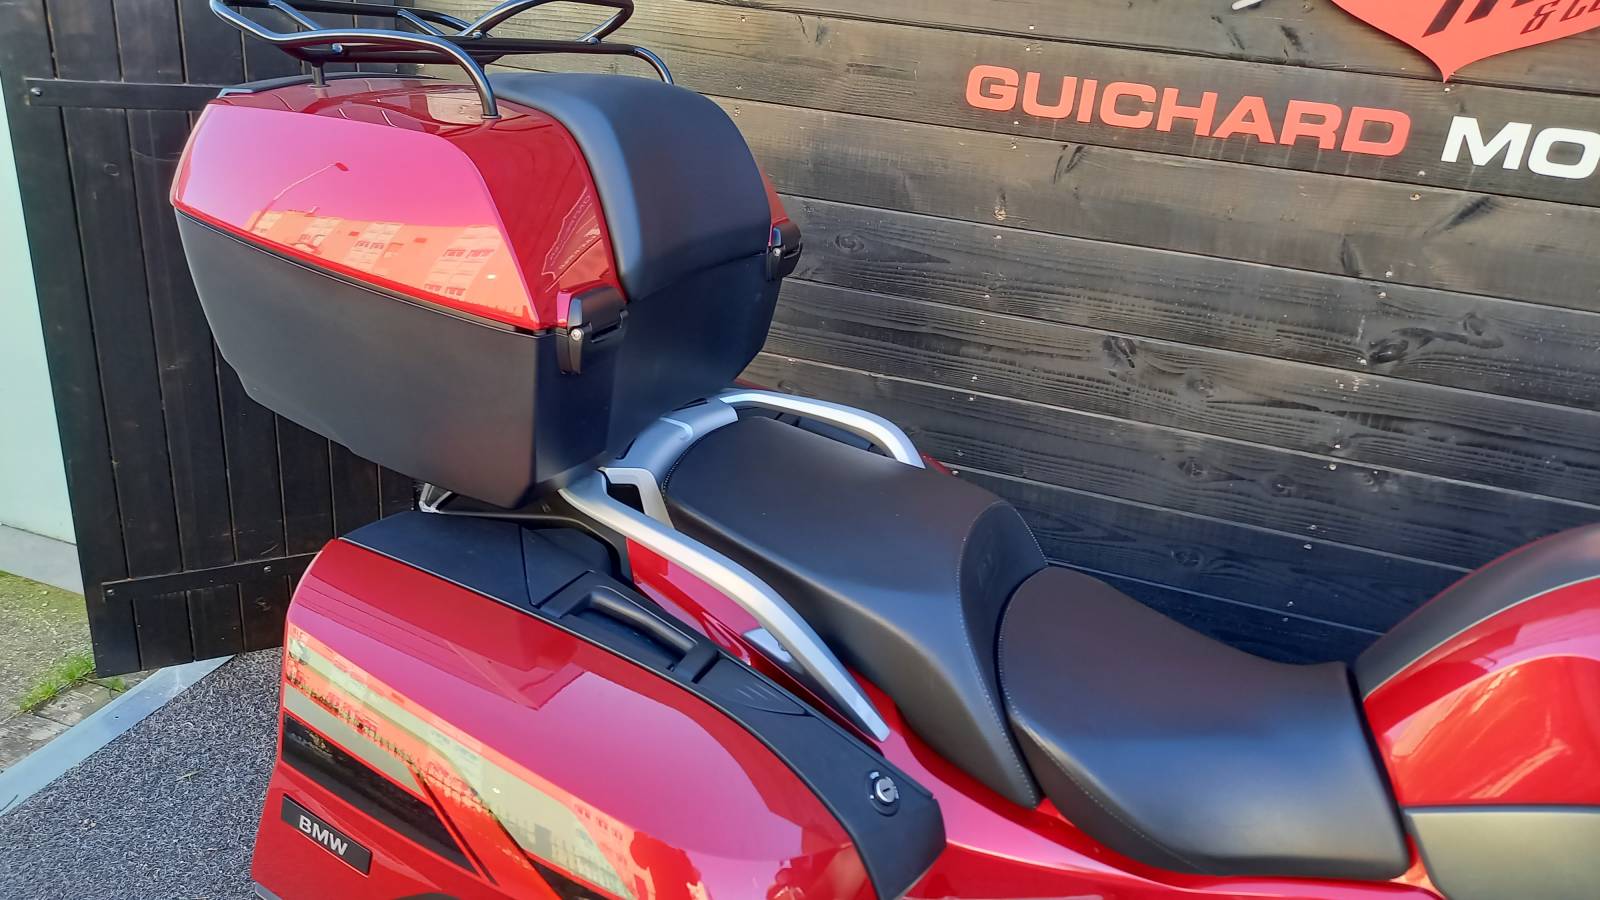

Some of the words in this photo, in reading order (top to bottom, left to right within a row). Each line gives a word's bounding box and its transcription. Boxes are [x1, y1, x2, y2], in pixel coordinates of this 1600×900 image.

[966, 65, 1411, 156] GUICHARD
[1441, 116, 1600, 179] MO
[299, 814, 348, 856] BMW
